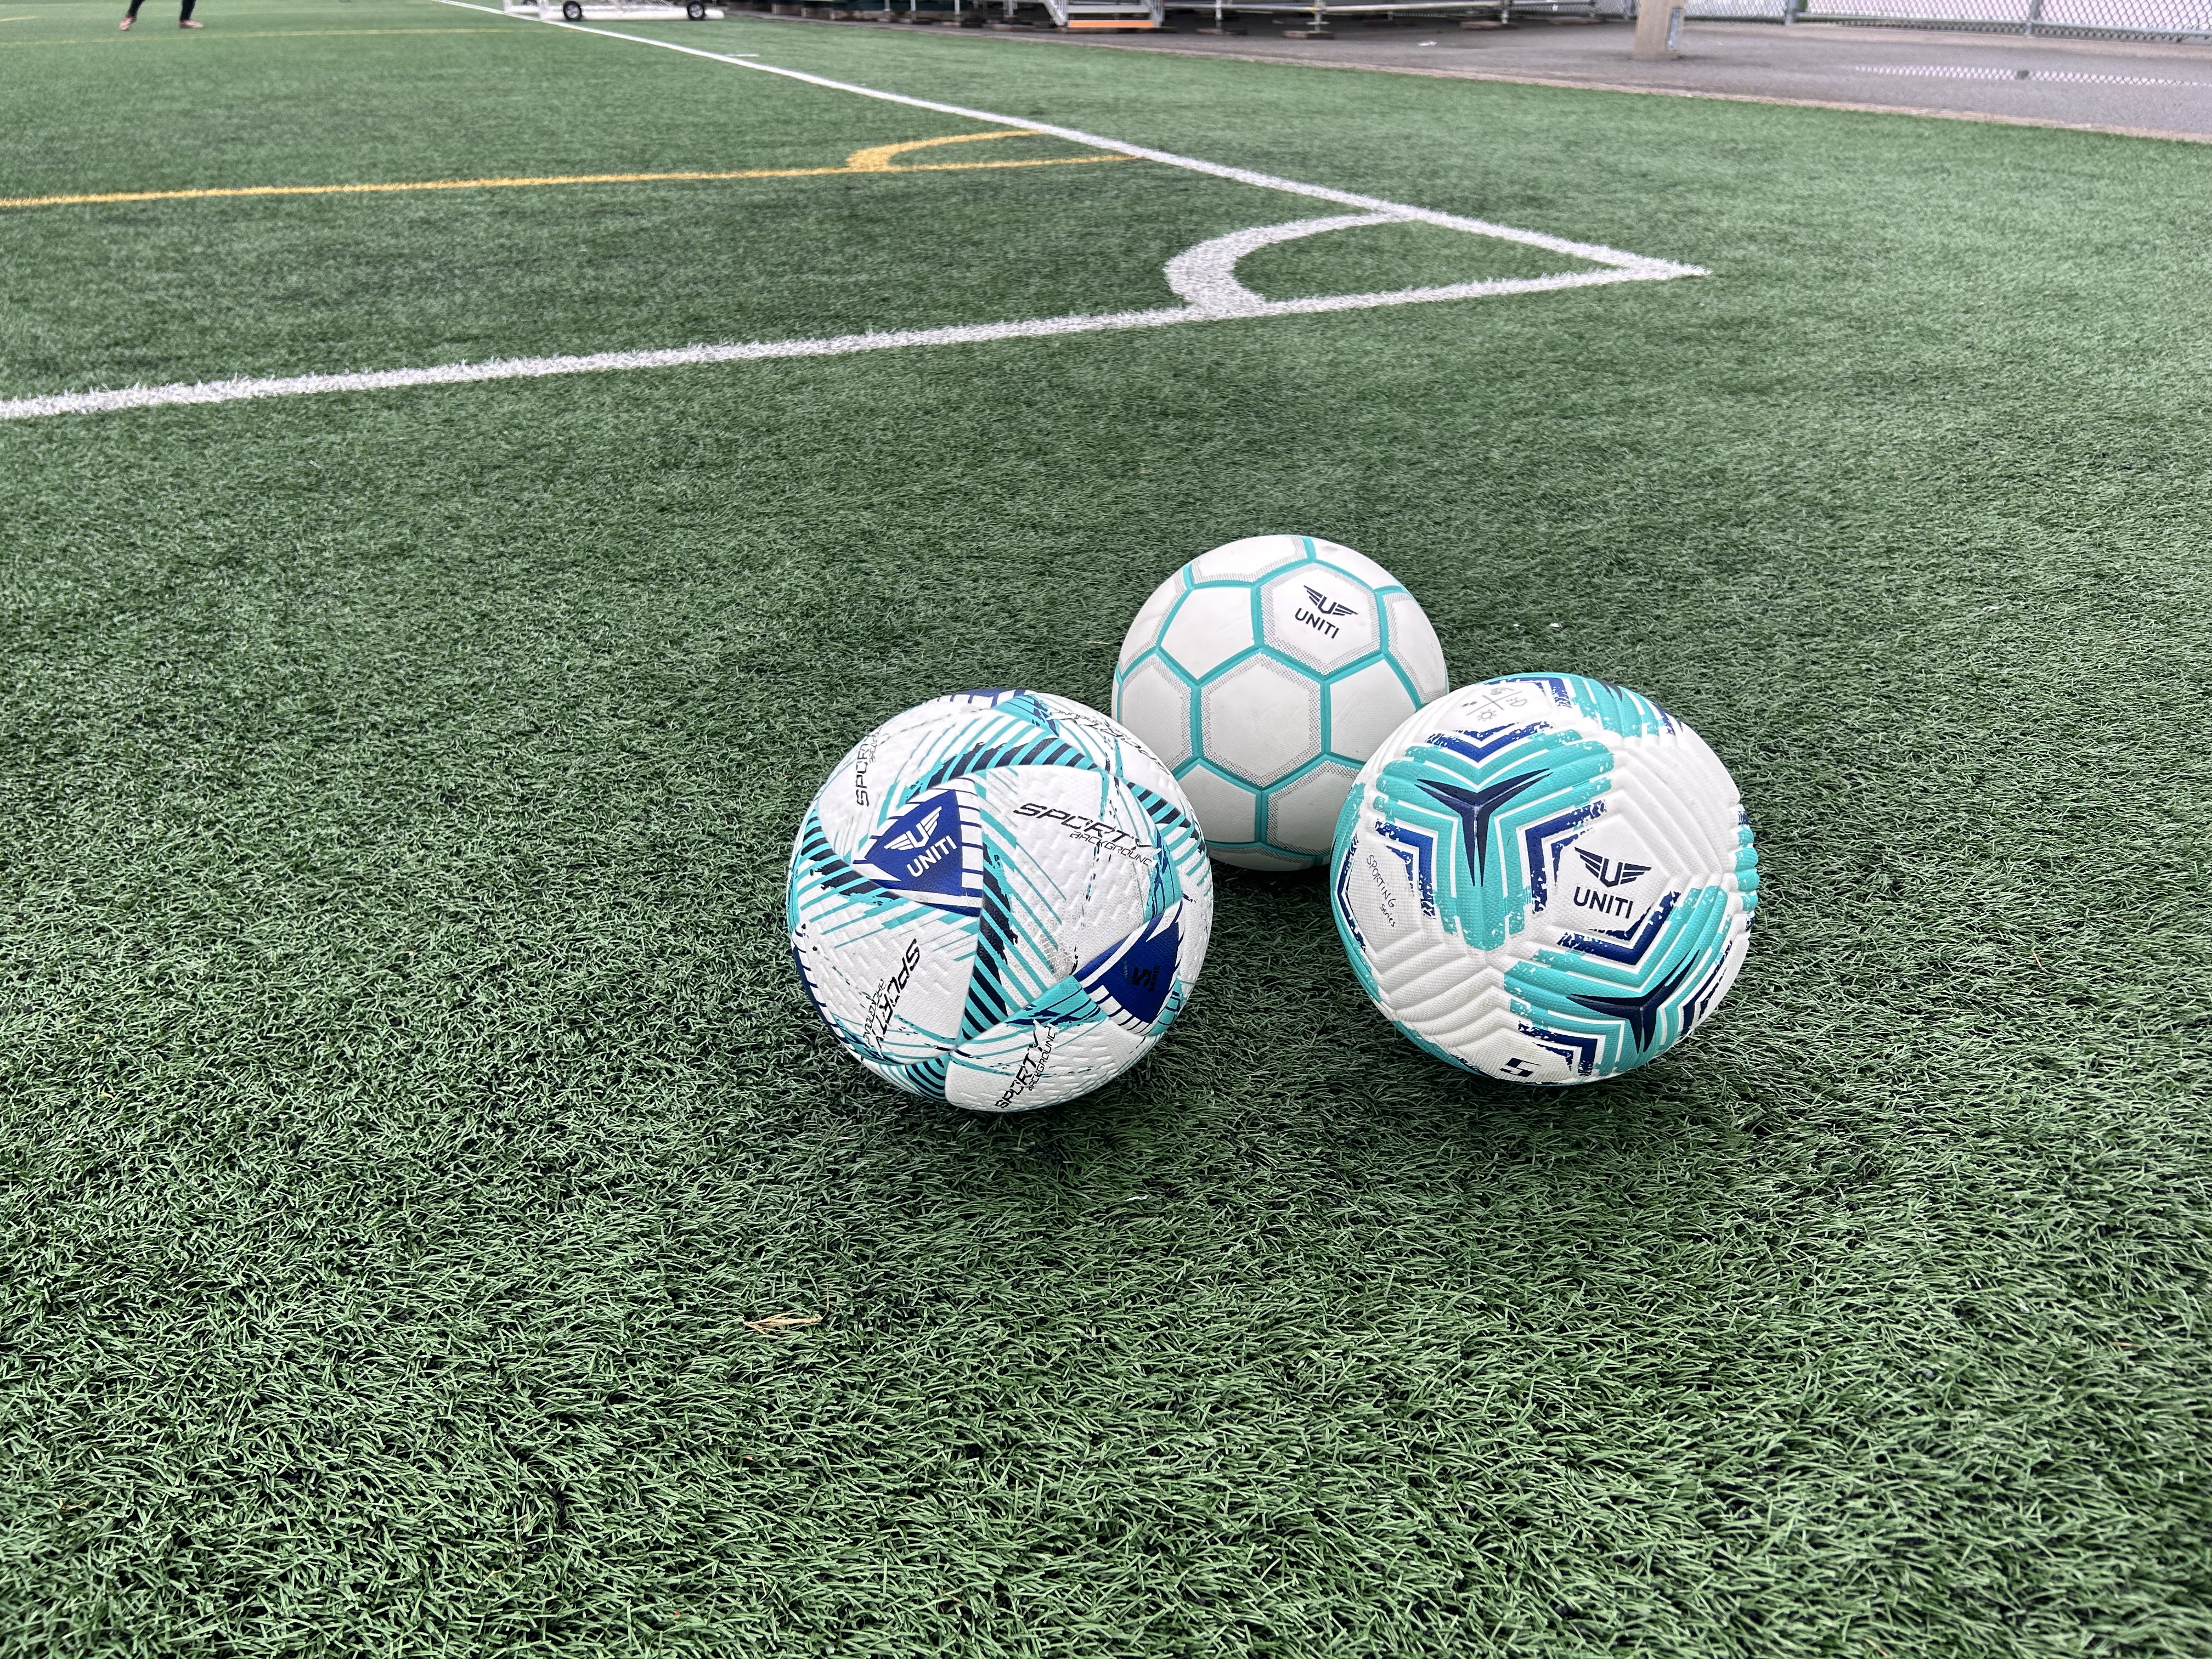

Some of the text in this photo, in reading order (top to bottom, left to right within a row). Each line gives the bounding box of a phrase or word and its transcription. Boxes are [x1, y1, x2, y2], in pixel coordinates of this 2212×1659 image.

[1295, 607, 1340, 639] UNITI
[1013, 803, 1152, 850] SPORTY
[906, 835, 957, 877] UNITI
[1573, 886, 1634, 919] UNITI
[871, 938, 921, 1051] SPORTY
[995, 1030, 1043, 1109] SPORTY
[1499, 1057, 1542, 1077] 5
